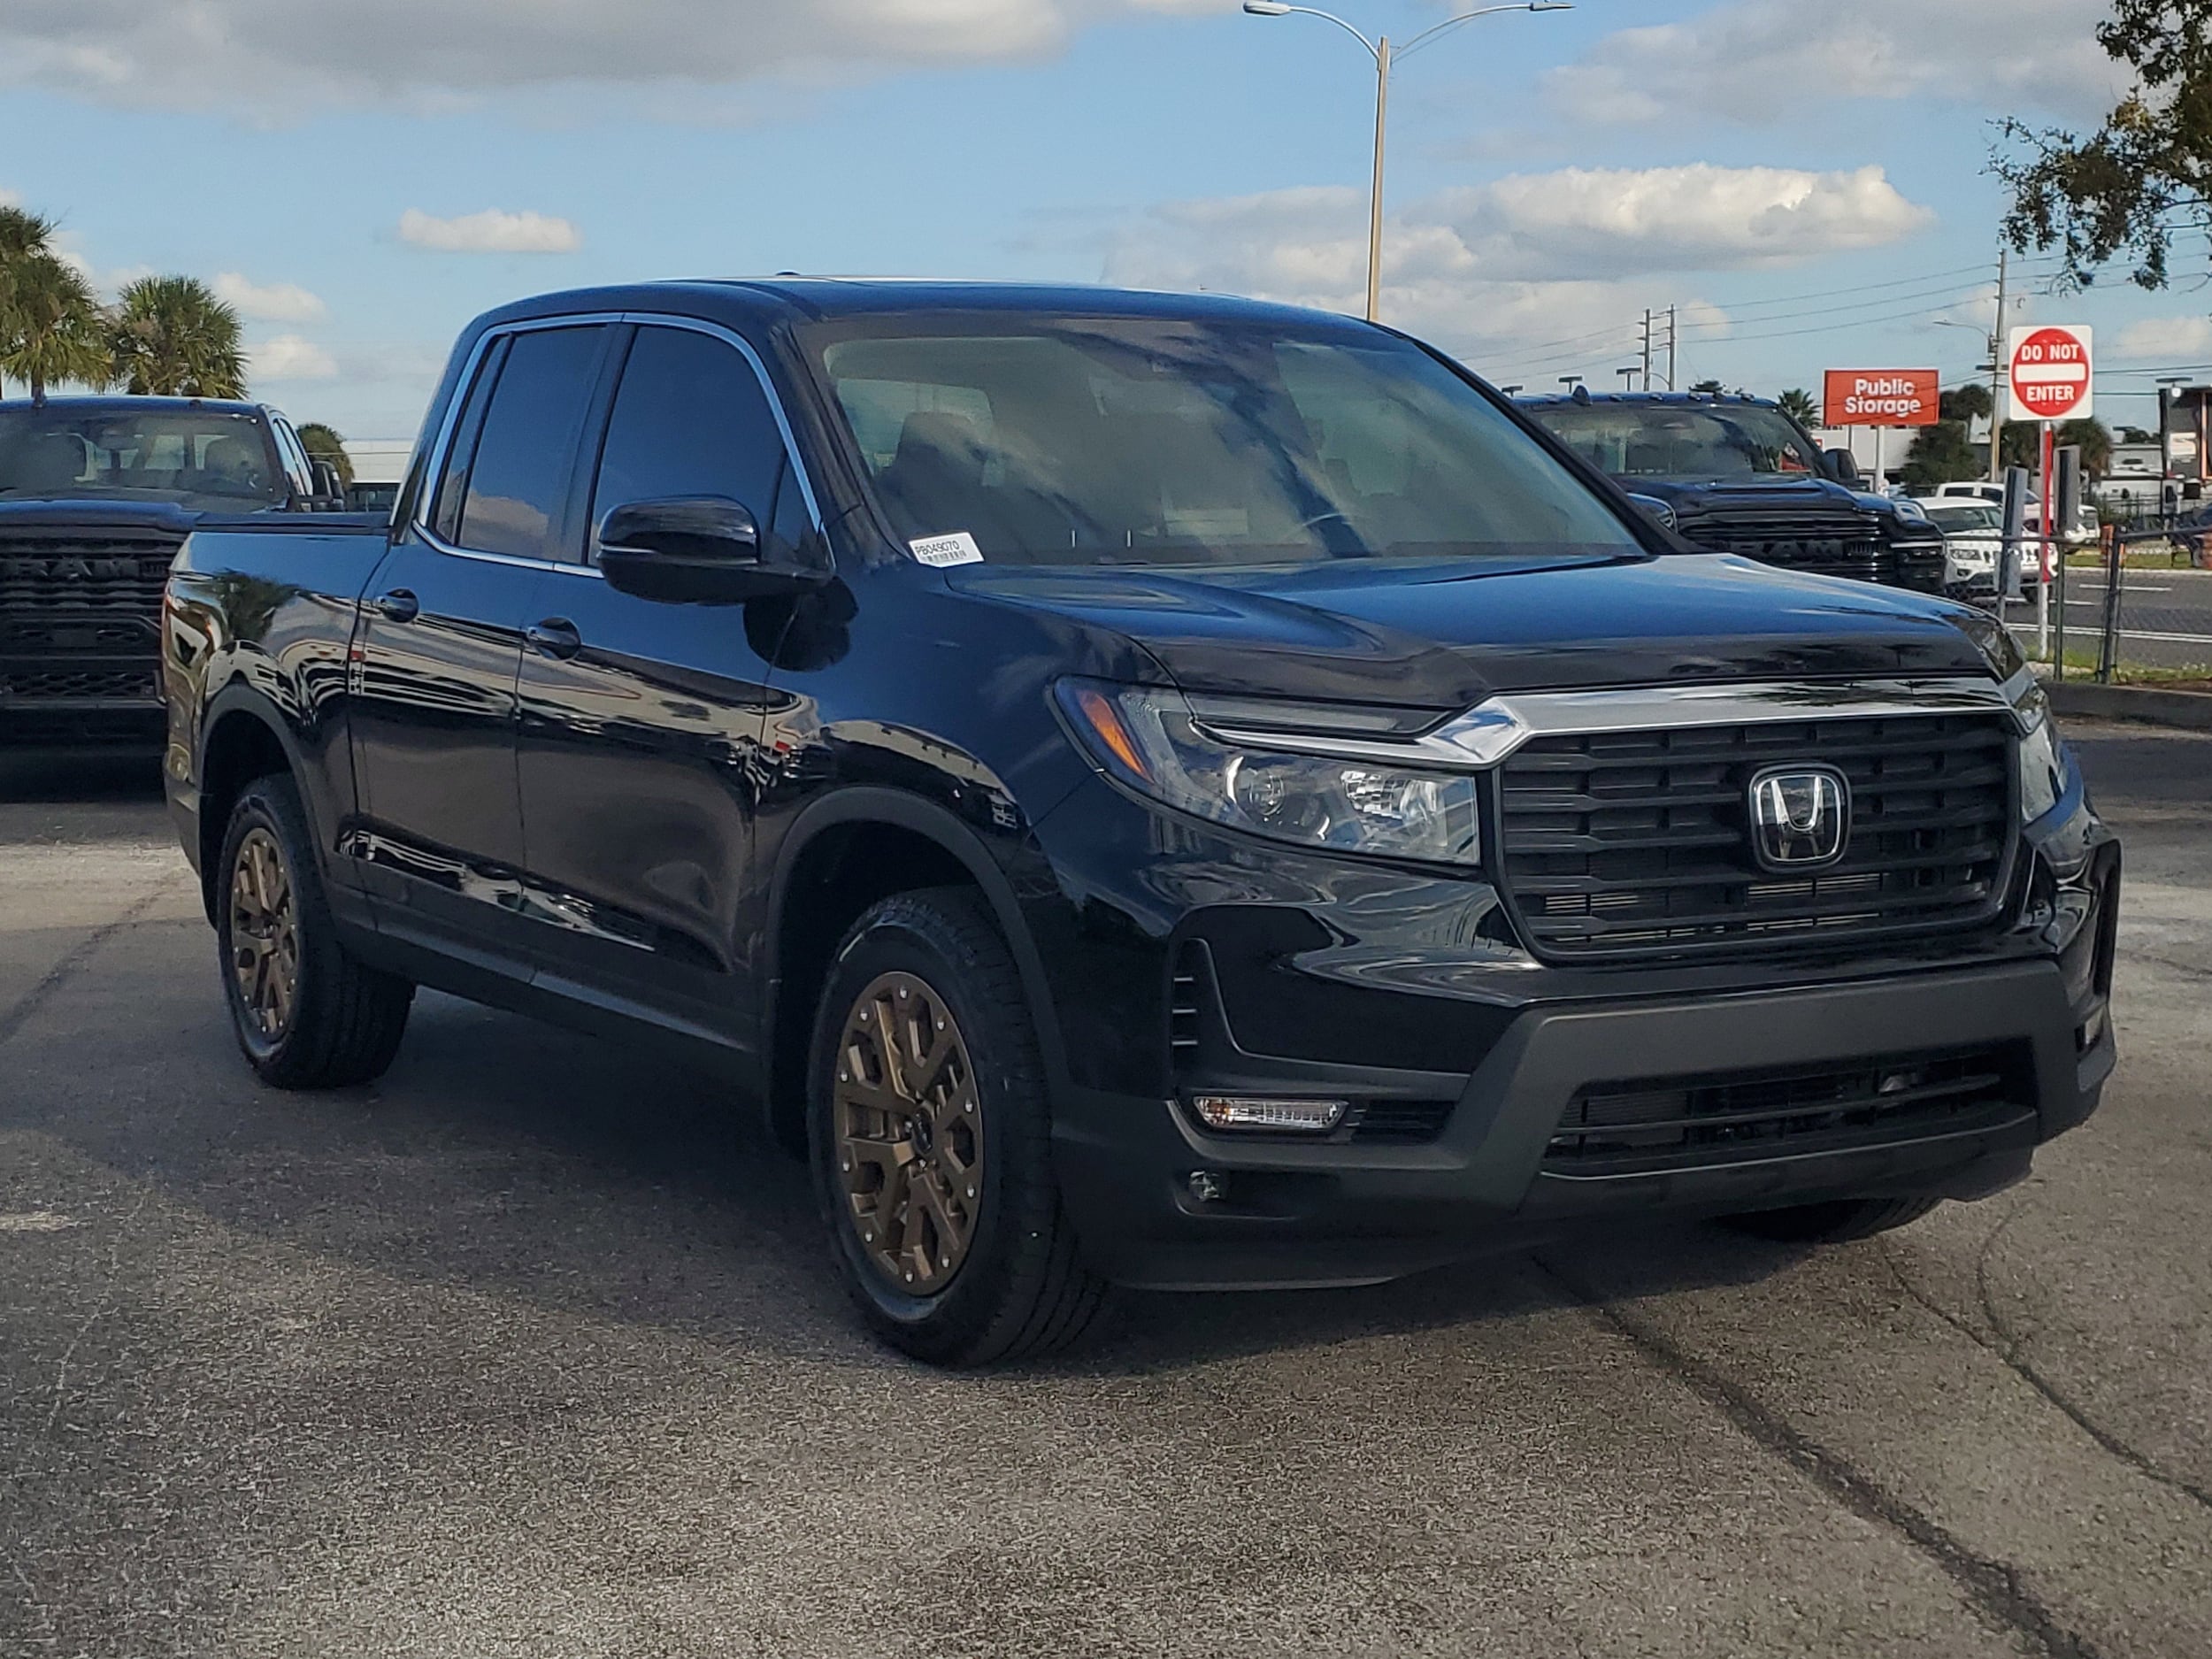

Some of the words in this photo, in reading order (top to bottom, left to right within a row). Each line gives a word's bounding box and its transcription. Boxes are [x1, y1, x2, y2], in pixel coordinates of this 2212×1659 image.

[2021, 344, 2043, 361] DO
[2049, 342, 2079, 360] NOT
[1855, 378, 1916, 396] Public
[2026, 385, 2074, 402] ENTER
[1845, 396, 1922, 418] Storage
